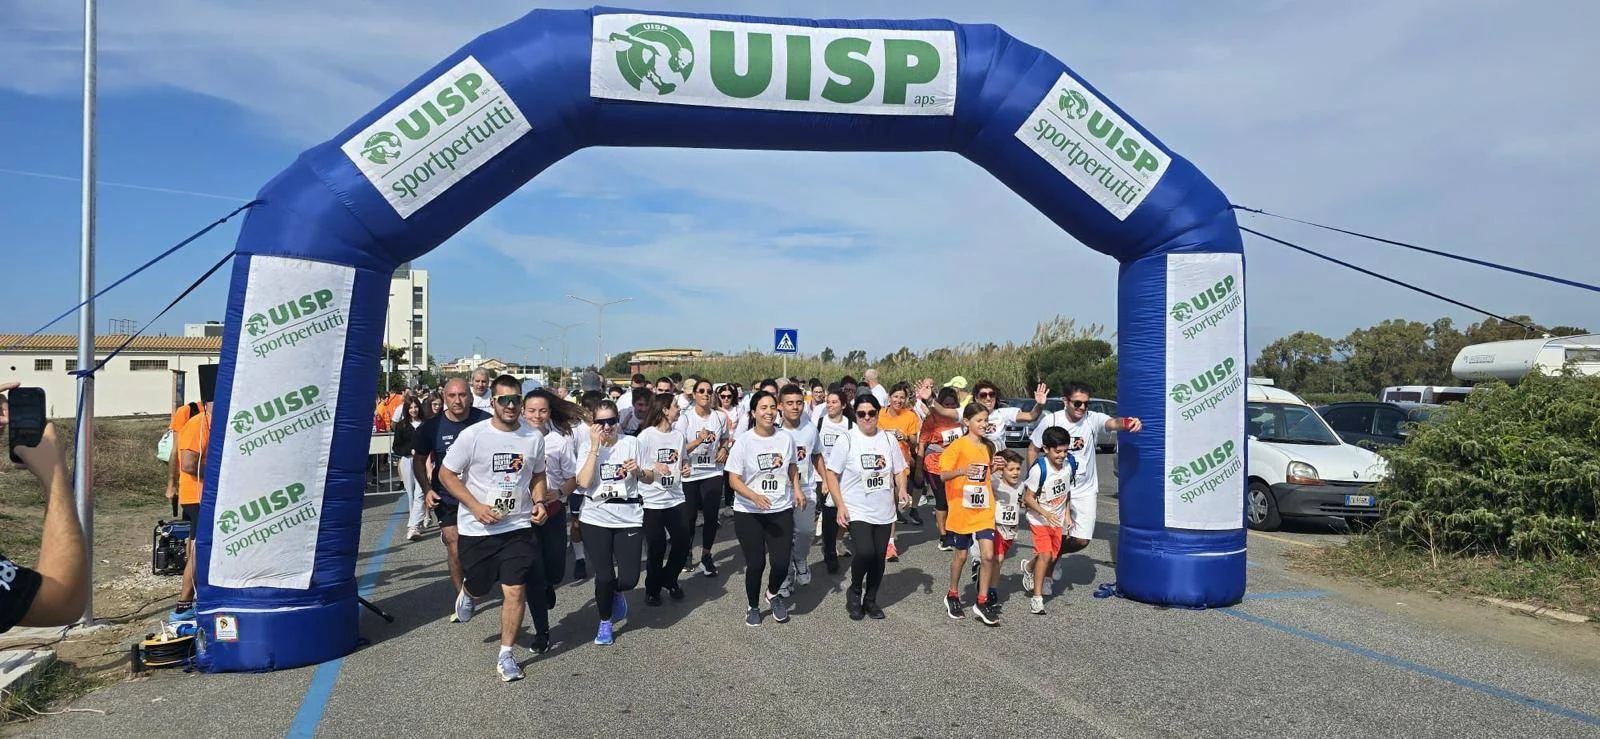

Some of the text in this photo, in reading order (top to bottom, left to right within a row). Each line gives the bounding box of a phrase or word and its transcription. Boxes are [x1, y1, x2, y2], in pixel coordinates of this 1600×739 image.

[643, 23, 668, 32] UISP
[710, 29, 941, 105] UISP
[395, 72, 484, 141] UISP
[914, 94, 936, 107] aps
[391, 100, 516, 199] sportpertutti
[1087, 109, 1159, 173] UISP
[1033, 118, 1142, 205] sportpertutti
[268, 288, 334, 326] UISP
[1190, 274, 1235, 311] UISP
[253, 310, 345, 358] sportpertutti
[1182, 291, 1242, 340] sportpertutti
[1190, 356, 1235, 393] UISP
[254, 384, 320, 423] UISP
[1181, 374, 1243, 421] sportpertutti
[239, 405, 331, 456] sportpertutti
[697, 456, 711, 465] 041
[1189, 439, 1235, 476] UISP
[661, 476, 675, 486] 017
[761, 480, 778, 490] 010
[867, 477, 884, 488] 005
[970, 494, 985, 504] 103
[1052, 483, 1066, 495] 133
[1180, 456, 1242, 504] sportpertutti
[239, 482, 306, 522] UISP
[1002, 511, 1017, 521] 134
[226, 502, 317, 556] sportpertutti
